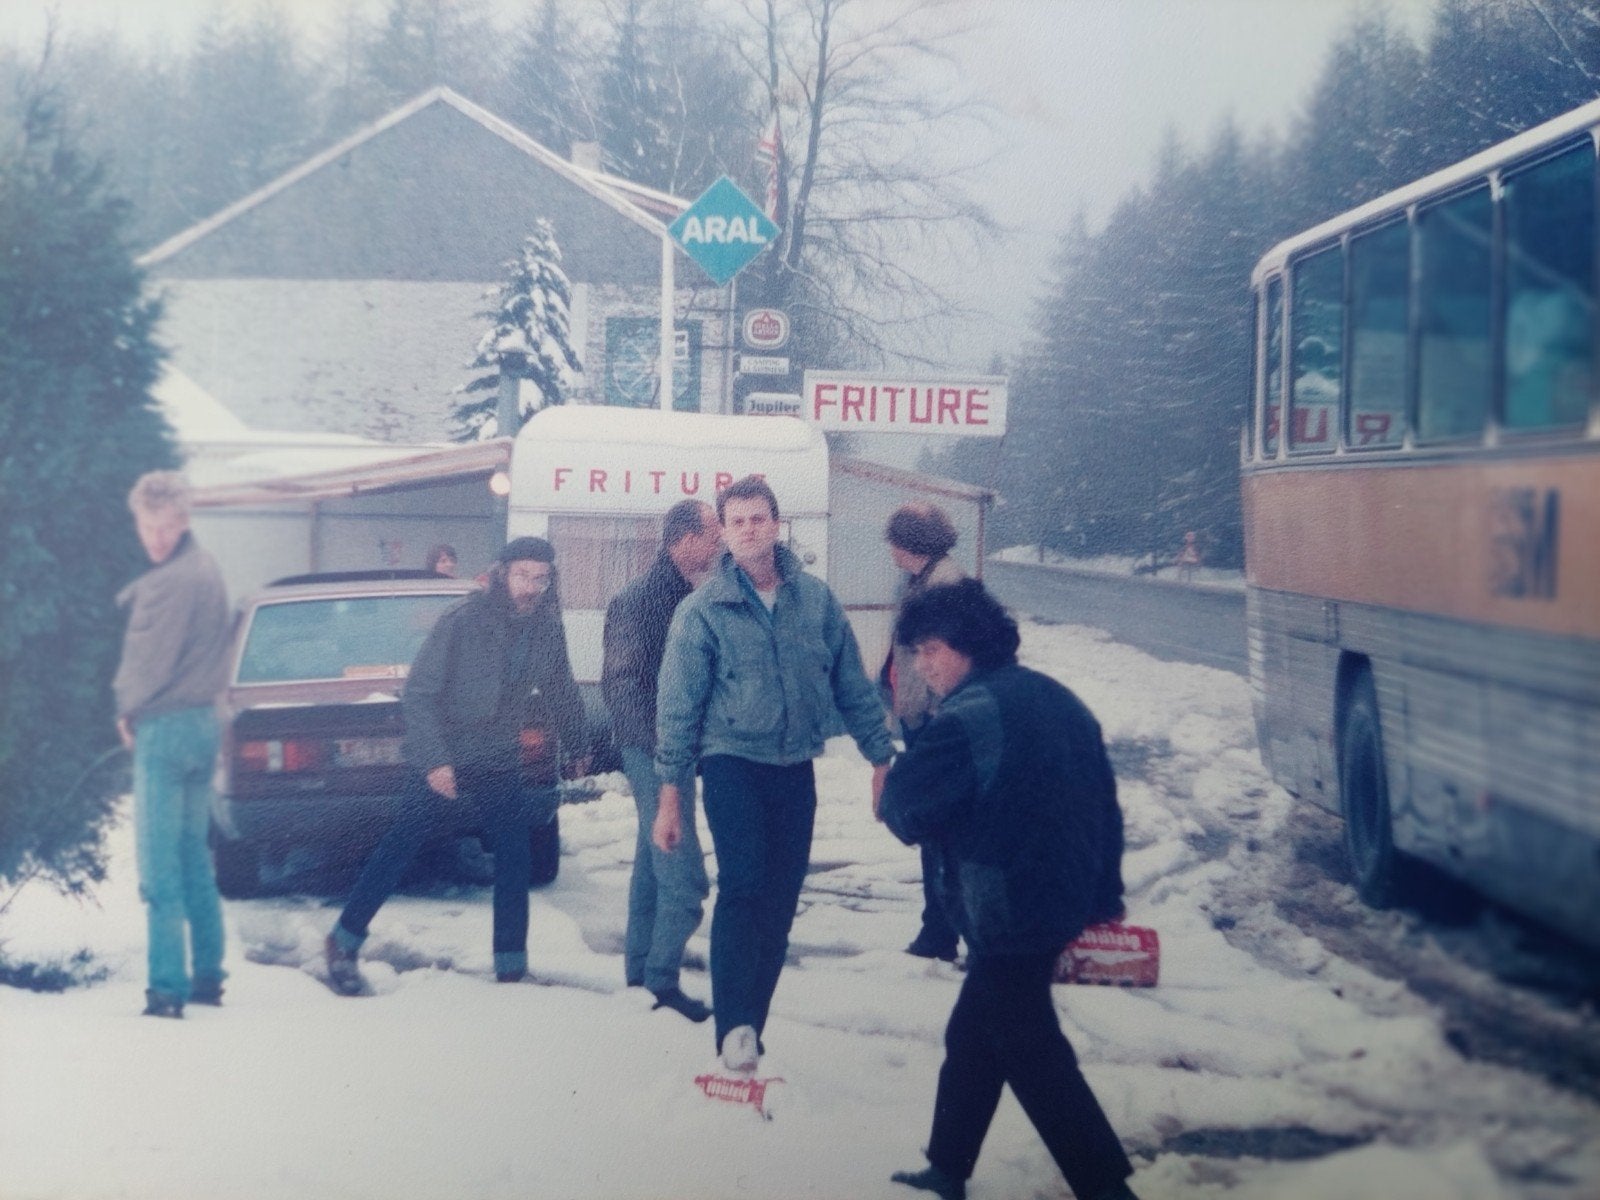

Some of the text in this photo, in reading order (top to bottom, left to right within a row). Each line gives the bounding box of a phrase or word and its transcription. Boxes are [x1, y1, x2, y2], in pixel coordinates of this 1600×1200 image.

[682, 215, 767, 244] ARAL
[749, 400, 800, 414] Jupiler
[814, 384, 989, 425] FRITURE
[554, 468, 767, 496] FRITUR
